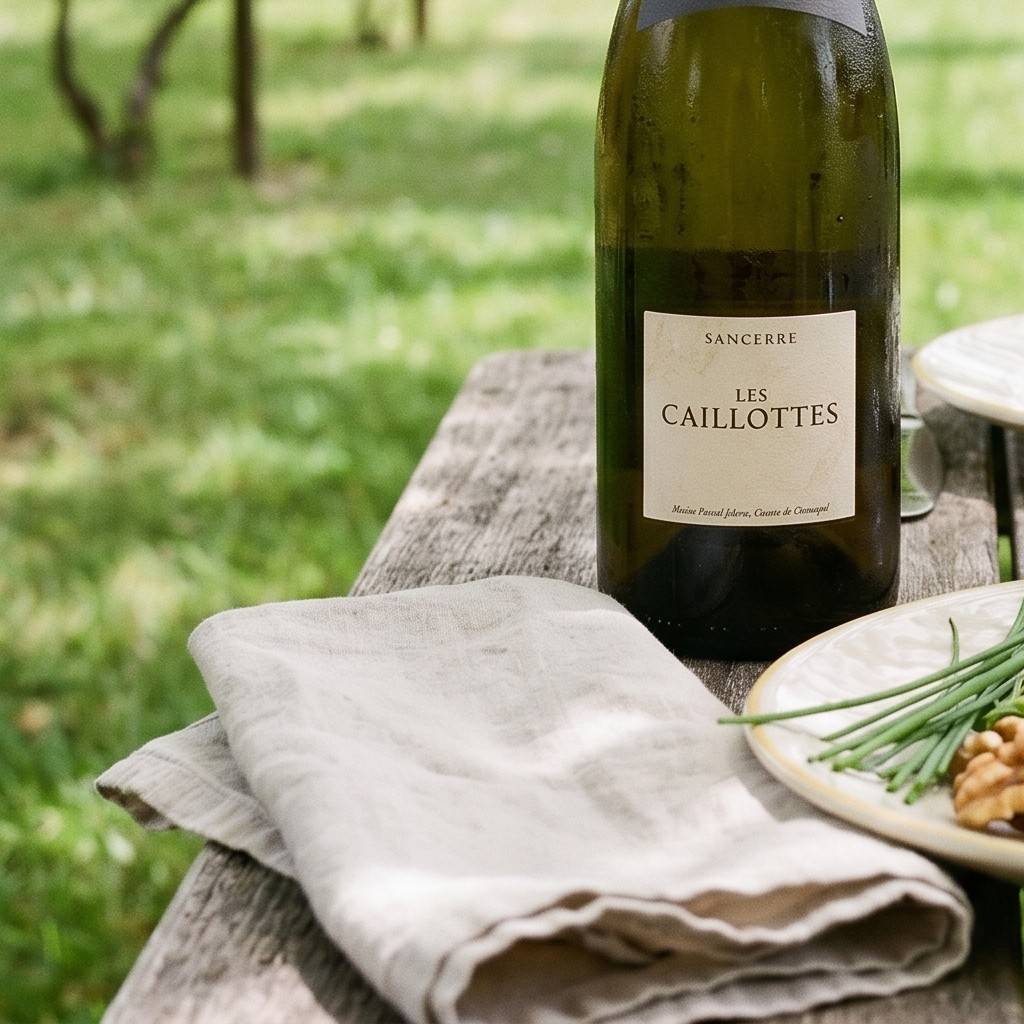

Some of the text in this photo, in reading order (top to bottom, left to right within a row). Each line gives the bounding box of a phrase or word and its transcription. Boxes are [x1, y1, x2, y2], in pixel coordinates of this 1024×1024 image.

[705, 332, 797, 346] SANCERRE
[735, 388, 768, 403] LES
[661, 402, 839, 430] CAILLOTTES
[782, 507, 792, 516] de
